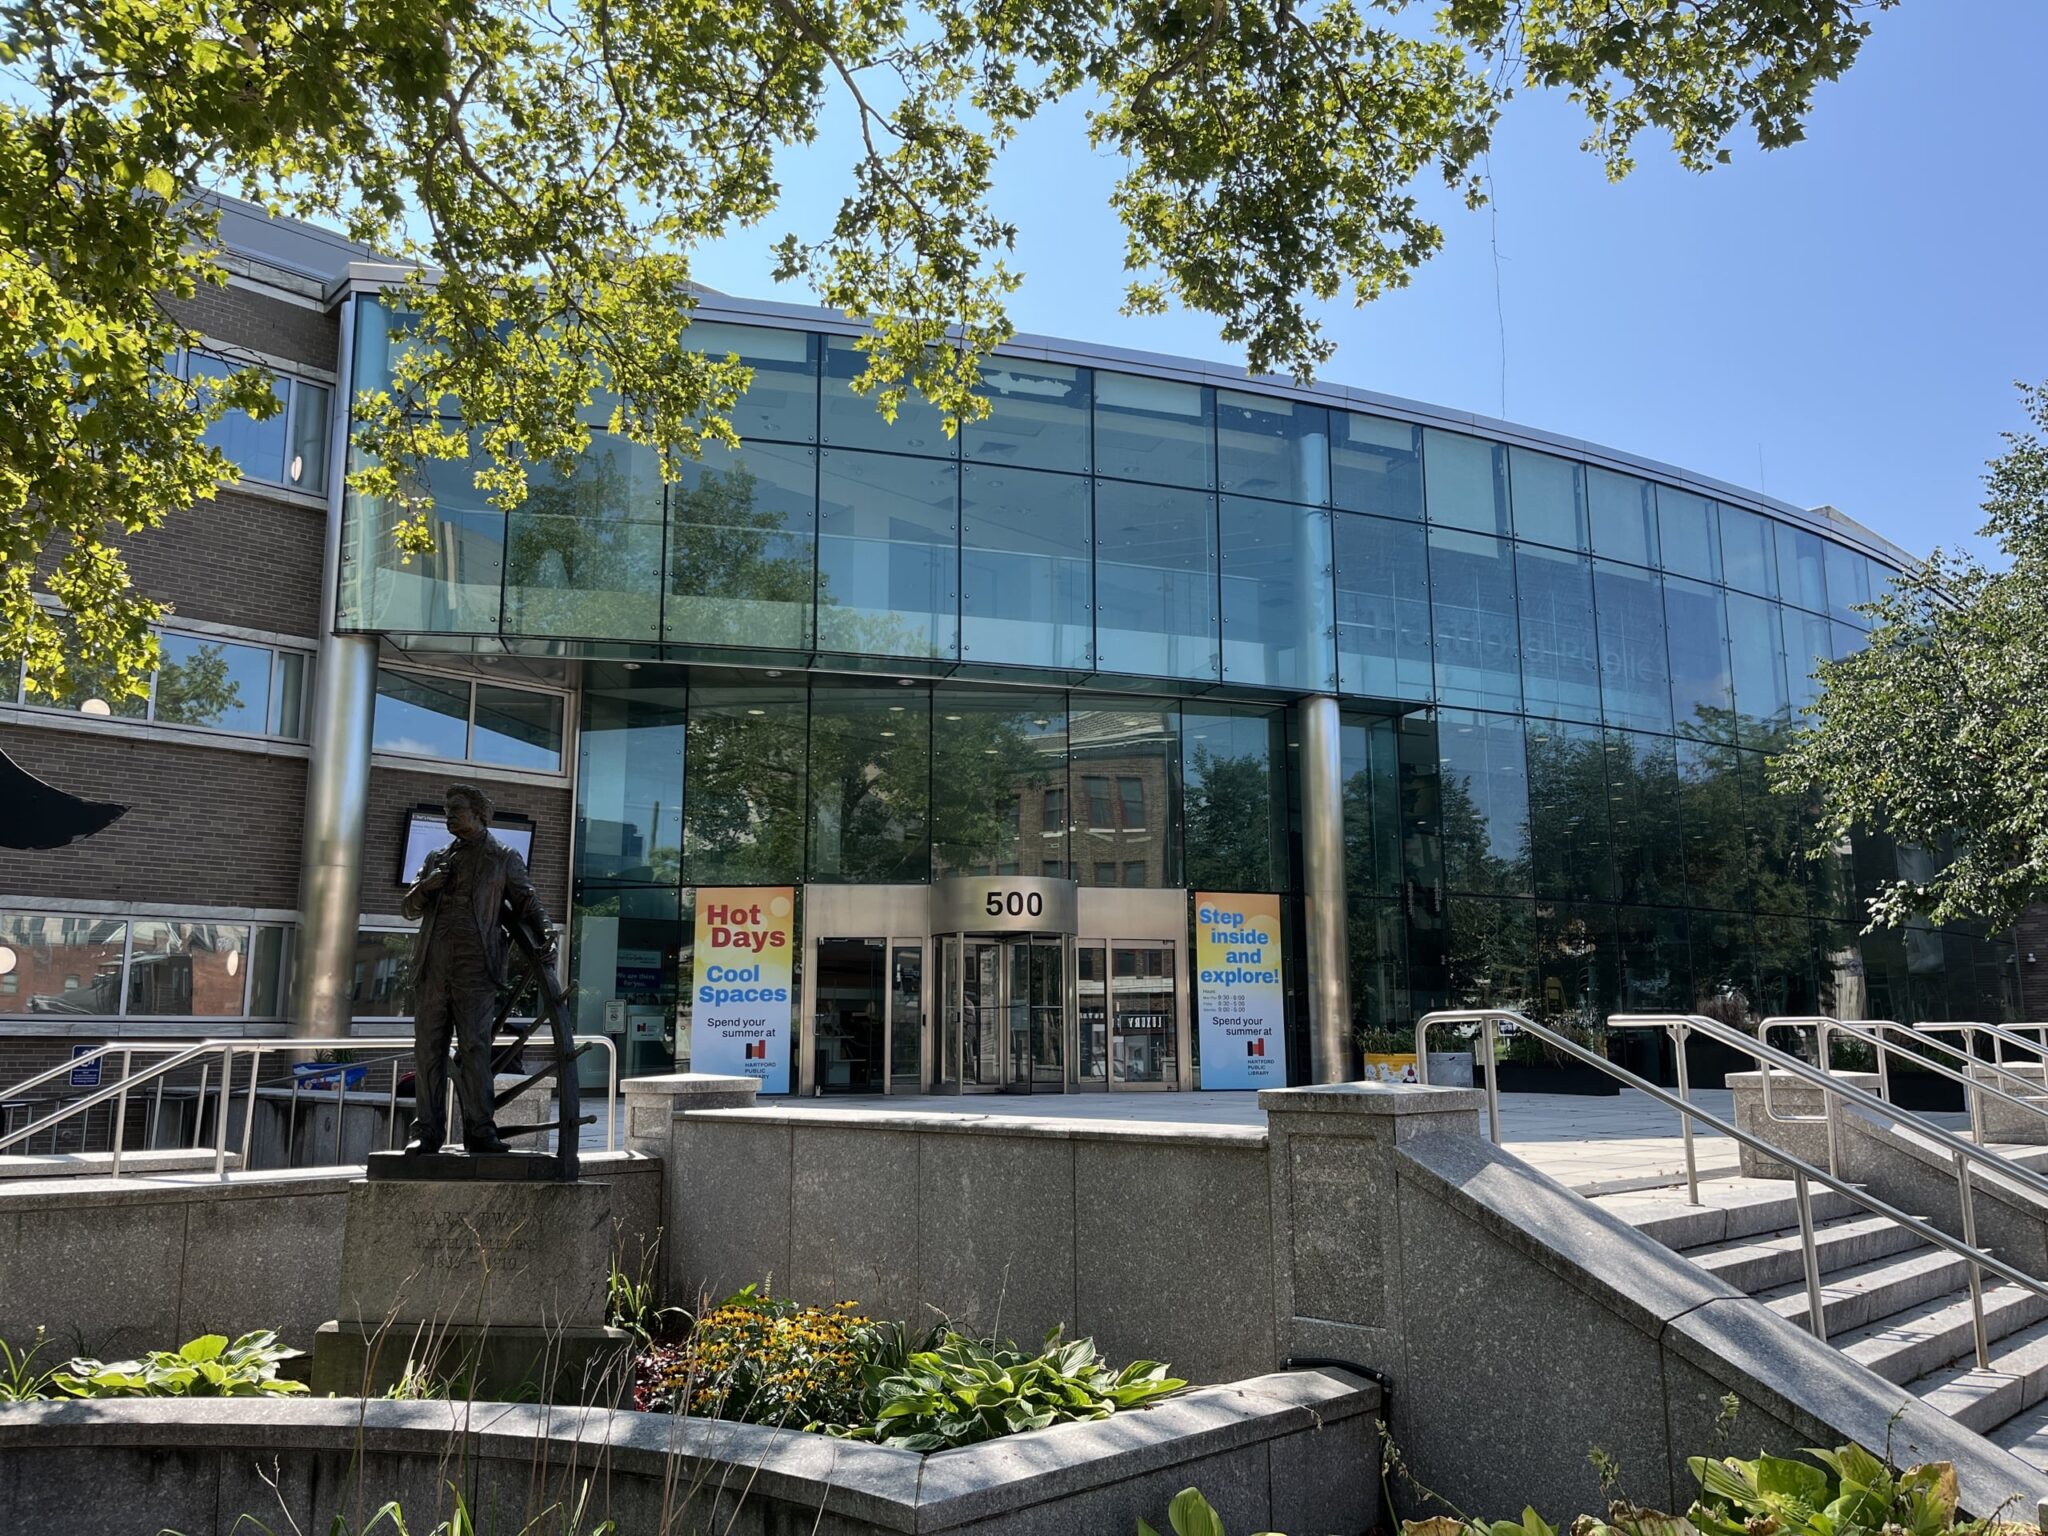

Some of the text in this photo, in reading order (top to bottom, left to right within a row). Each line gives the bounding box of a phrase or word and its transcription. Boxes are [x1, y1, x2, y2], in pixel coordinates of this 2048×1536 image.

[986, 891, 1043, 917] 500
[707, 904, 761, 926] Hot
[1200, 908, 1244, 928] Step
[711, 927, 786, 953] Days
[1211, 928, 1268, 945] inside
[1226, 948, 1261, 964] and
[706, 964, 760, 983] Cool
[1200, 968, 1279, 987] explore!
[699, 985, 787, 1007] Spaces
[707, 1018, 766, 1030] Spend your
[1212, 1016, 1263, 1027] Spend your
[722, 1029, 776, 1038] summer at
[1226, 1028, 1272, 1036] summer at
[410, 1211, 468, 1226] MARK
